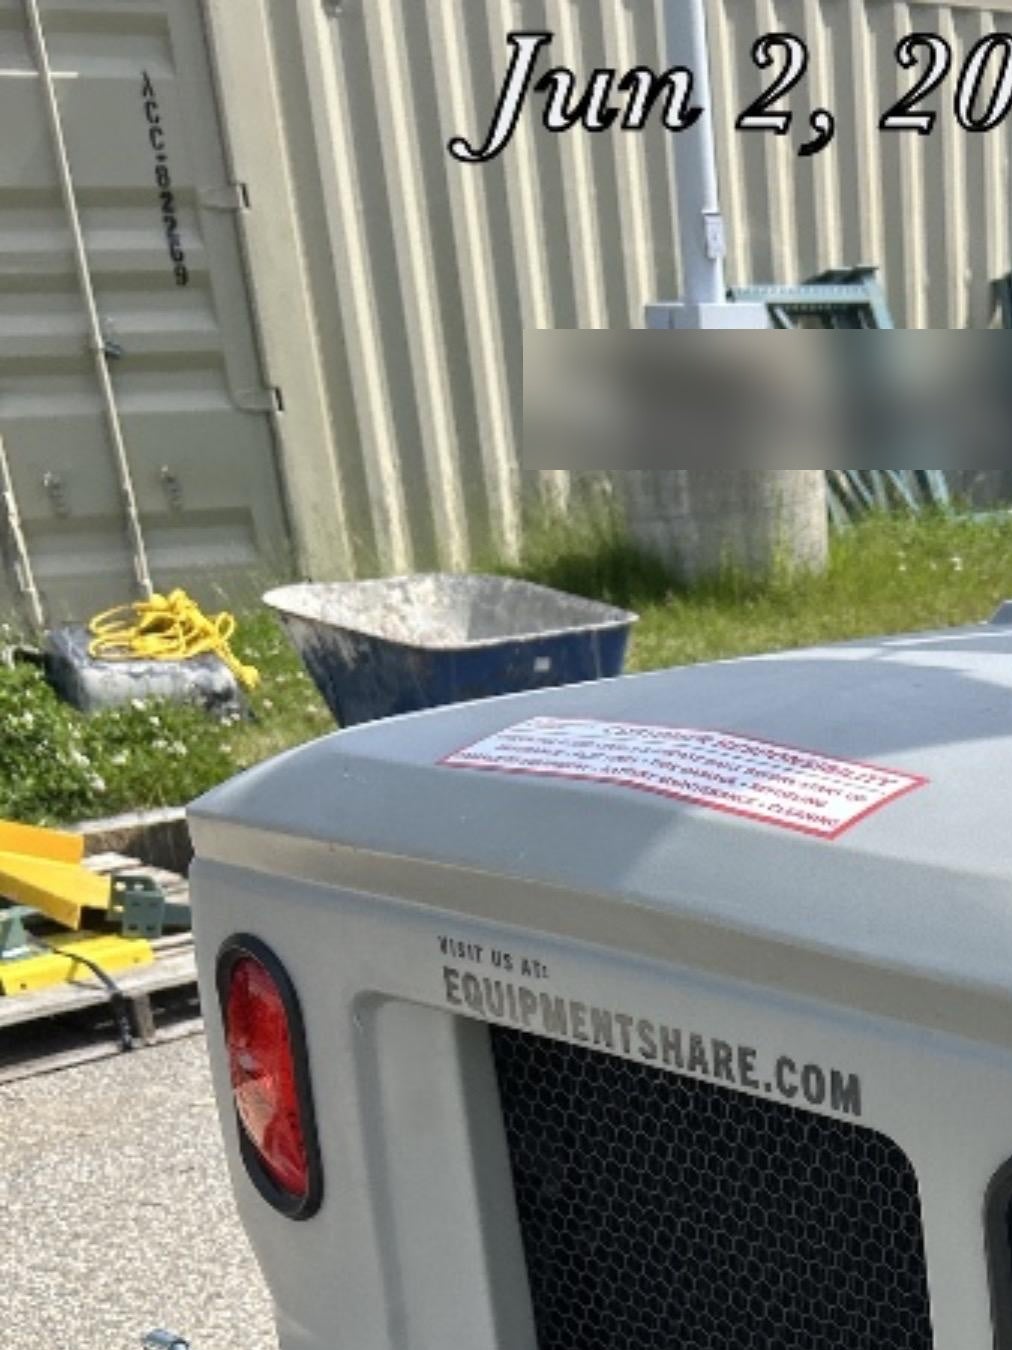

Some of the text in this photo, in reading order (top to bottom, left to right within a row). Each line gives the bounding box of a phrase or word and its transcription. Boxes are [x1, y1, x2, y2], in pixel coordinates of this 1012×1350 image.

[437, 934, 549, 979] VISIT US AT:
[442, 965, 862, 1117] EQUIPMENTSHARE.COM
